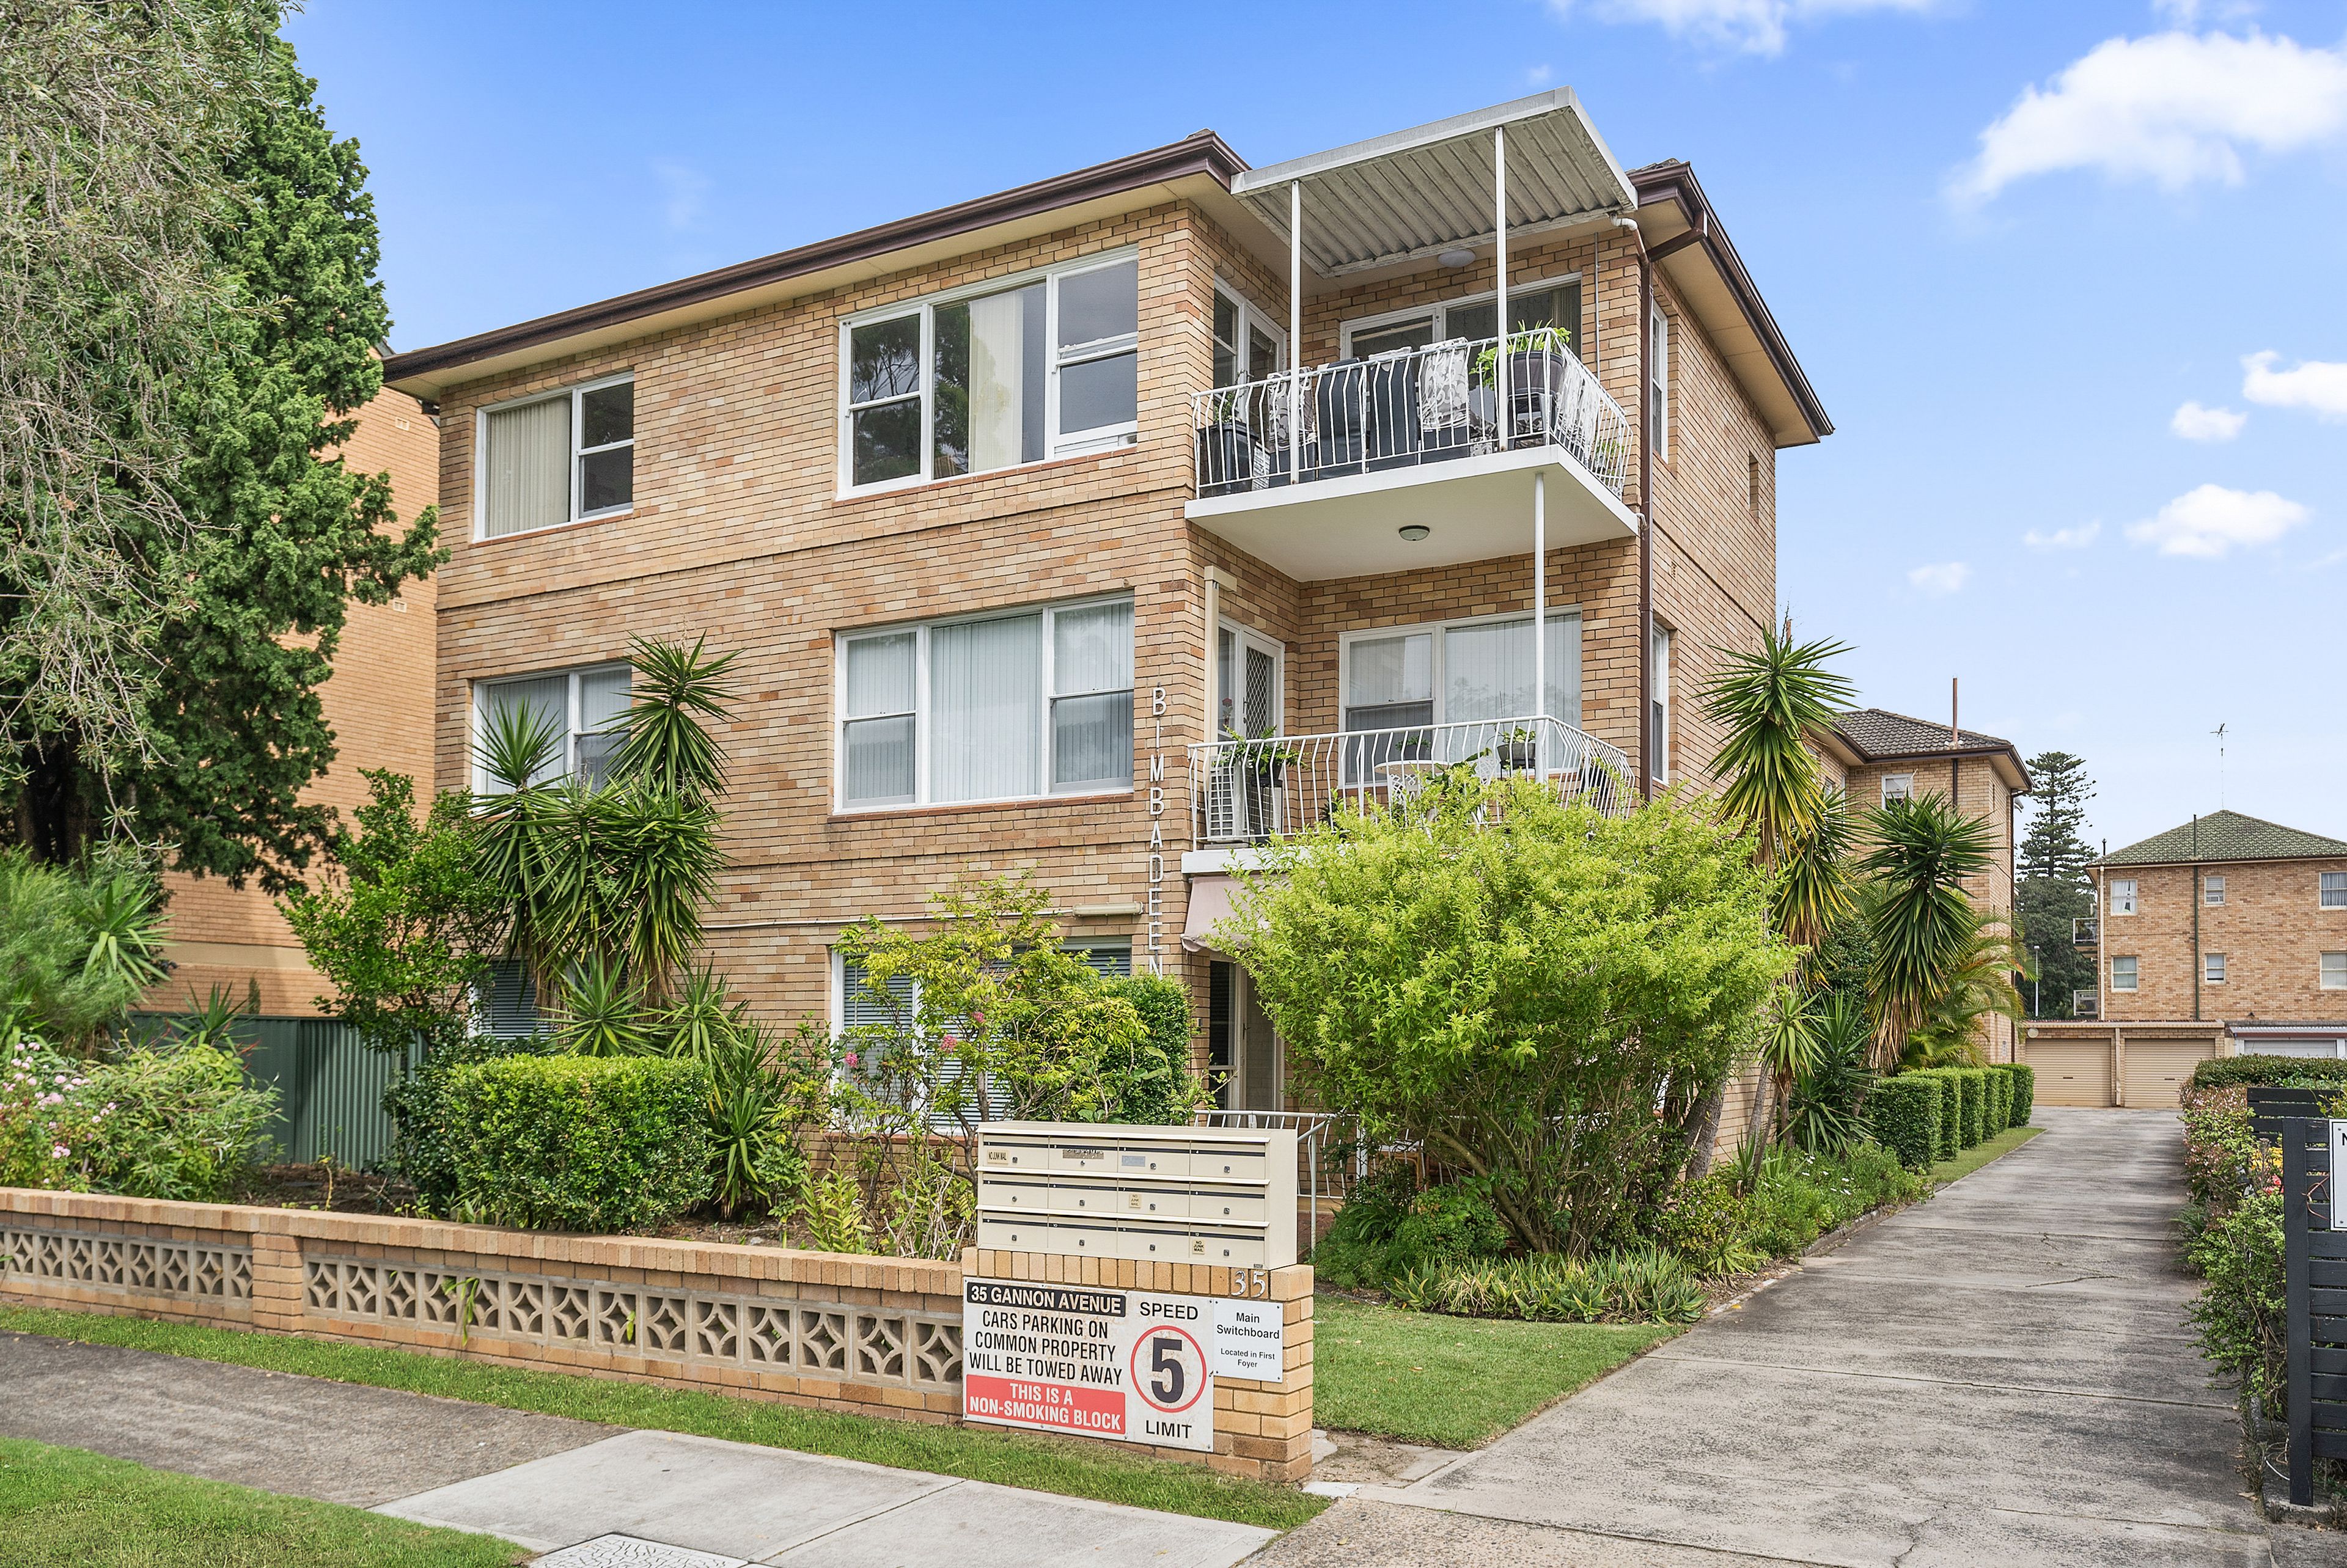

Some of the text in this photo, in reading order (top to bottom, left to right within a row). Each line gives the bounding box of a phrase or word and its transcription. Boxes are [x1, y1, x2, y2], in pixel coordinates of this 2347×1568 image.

[1148, 687, 1167, 981] BIMBADEEN
[1231, 1270, 1266, 1299] 35
[971, 1285, 1121, 1314] 35 GANNON AVENUE
[1140, 1302, 1198, 1320] SPEED
[983, 1310, 1108, 1339] CARS PARKING ON
[1217, 1324, 1279, 1339] Switchboard
[1236, 1312, 1260, 1323] Main
[975, 1331, 1116, 1362] COMMON PROPERTY
[1221, 1348, 1248, 1357] Located
[969, 1352, 1122, 1385] WILL BE TOWED AWAY
[1151, 1337, 1184, 1403] 5
[1238, 1359, 1257, 1368] Foyer
[1010, 1383, 1073, 1405] THIS IS A
[969, 1396, 1121, 1431] NON-SMOKING BLOCK
[1146, 1420, 1192, 1438] LIMIT
